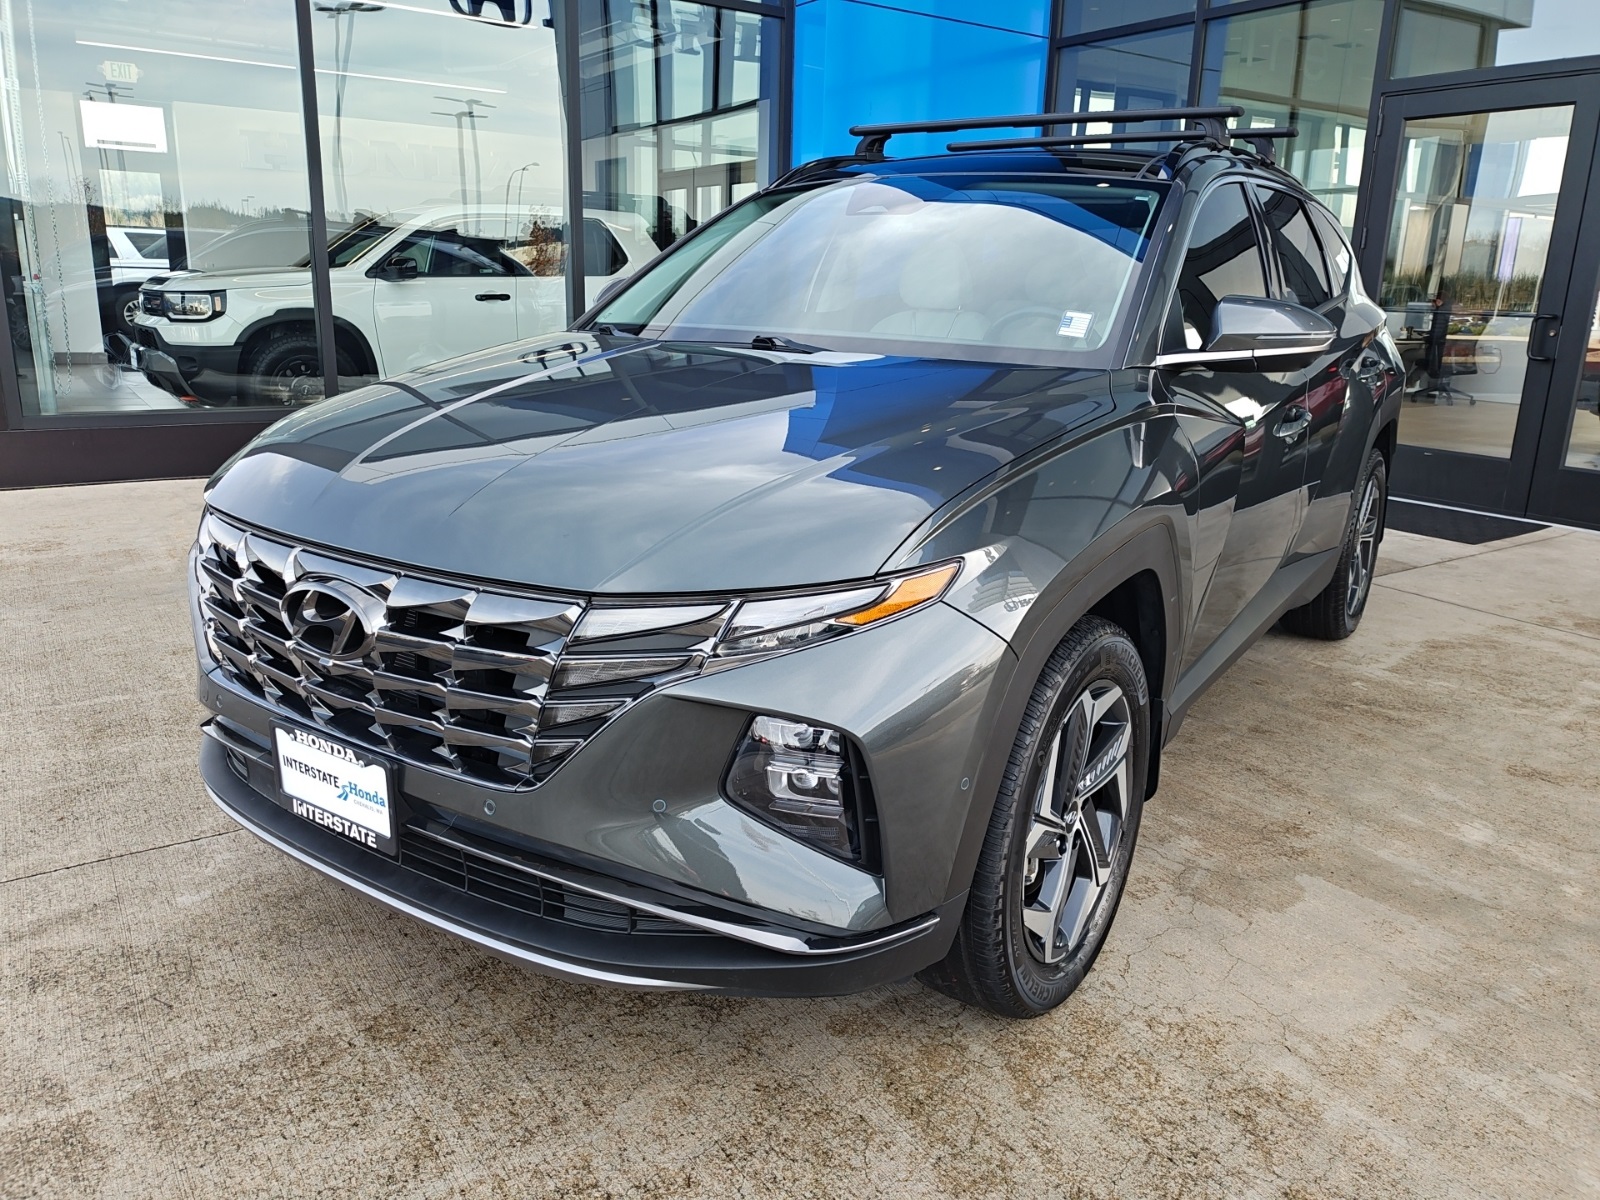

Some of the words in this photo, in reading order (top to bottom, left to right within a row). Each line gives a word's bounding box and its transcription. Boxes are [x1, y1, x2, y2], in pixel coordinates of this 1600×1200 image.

[110, 62, 132, 80] EXIT
[294, 729, 360, 765] HONDA
[283, 755, 340, 789] INTERSTATE
[347, 781, 386, 808] Honda
[293, 798, 378, 848] INTERSTATE
